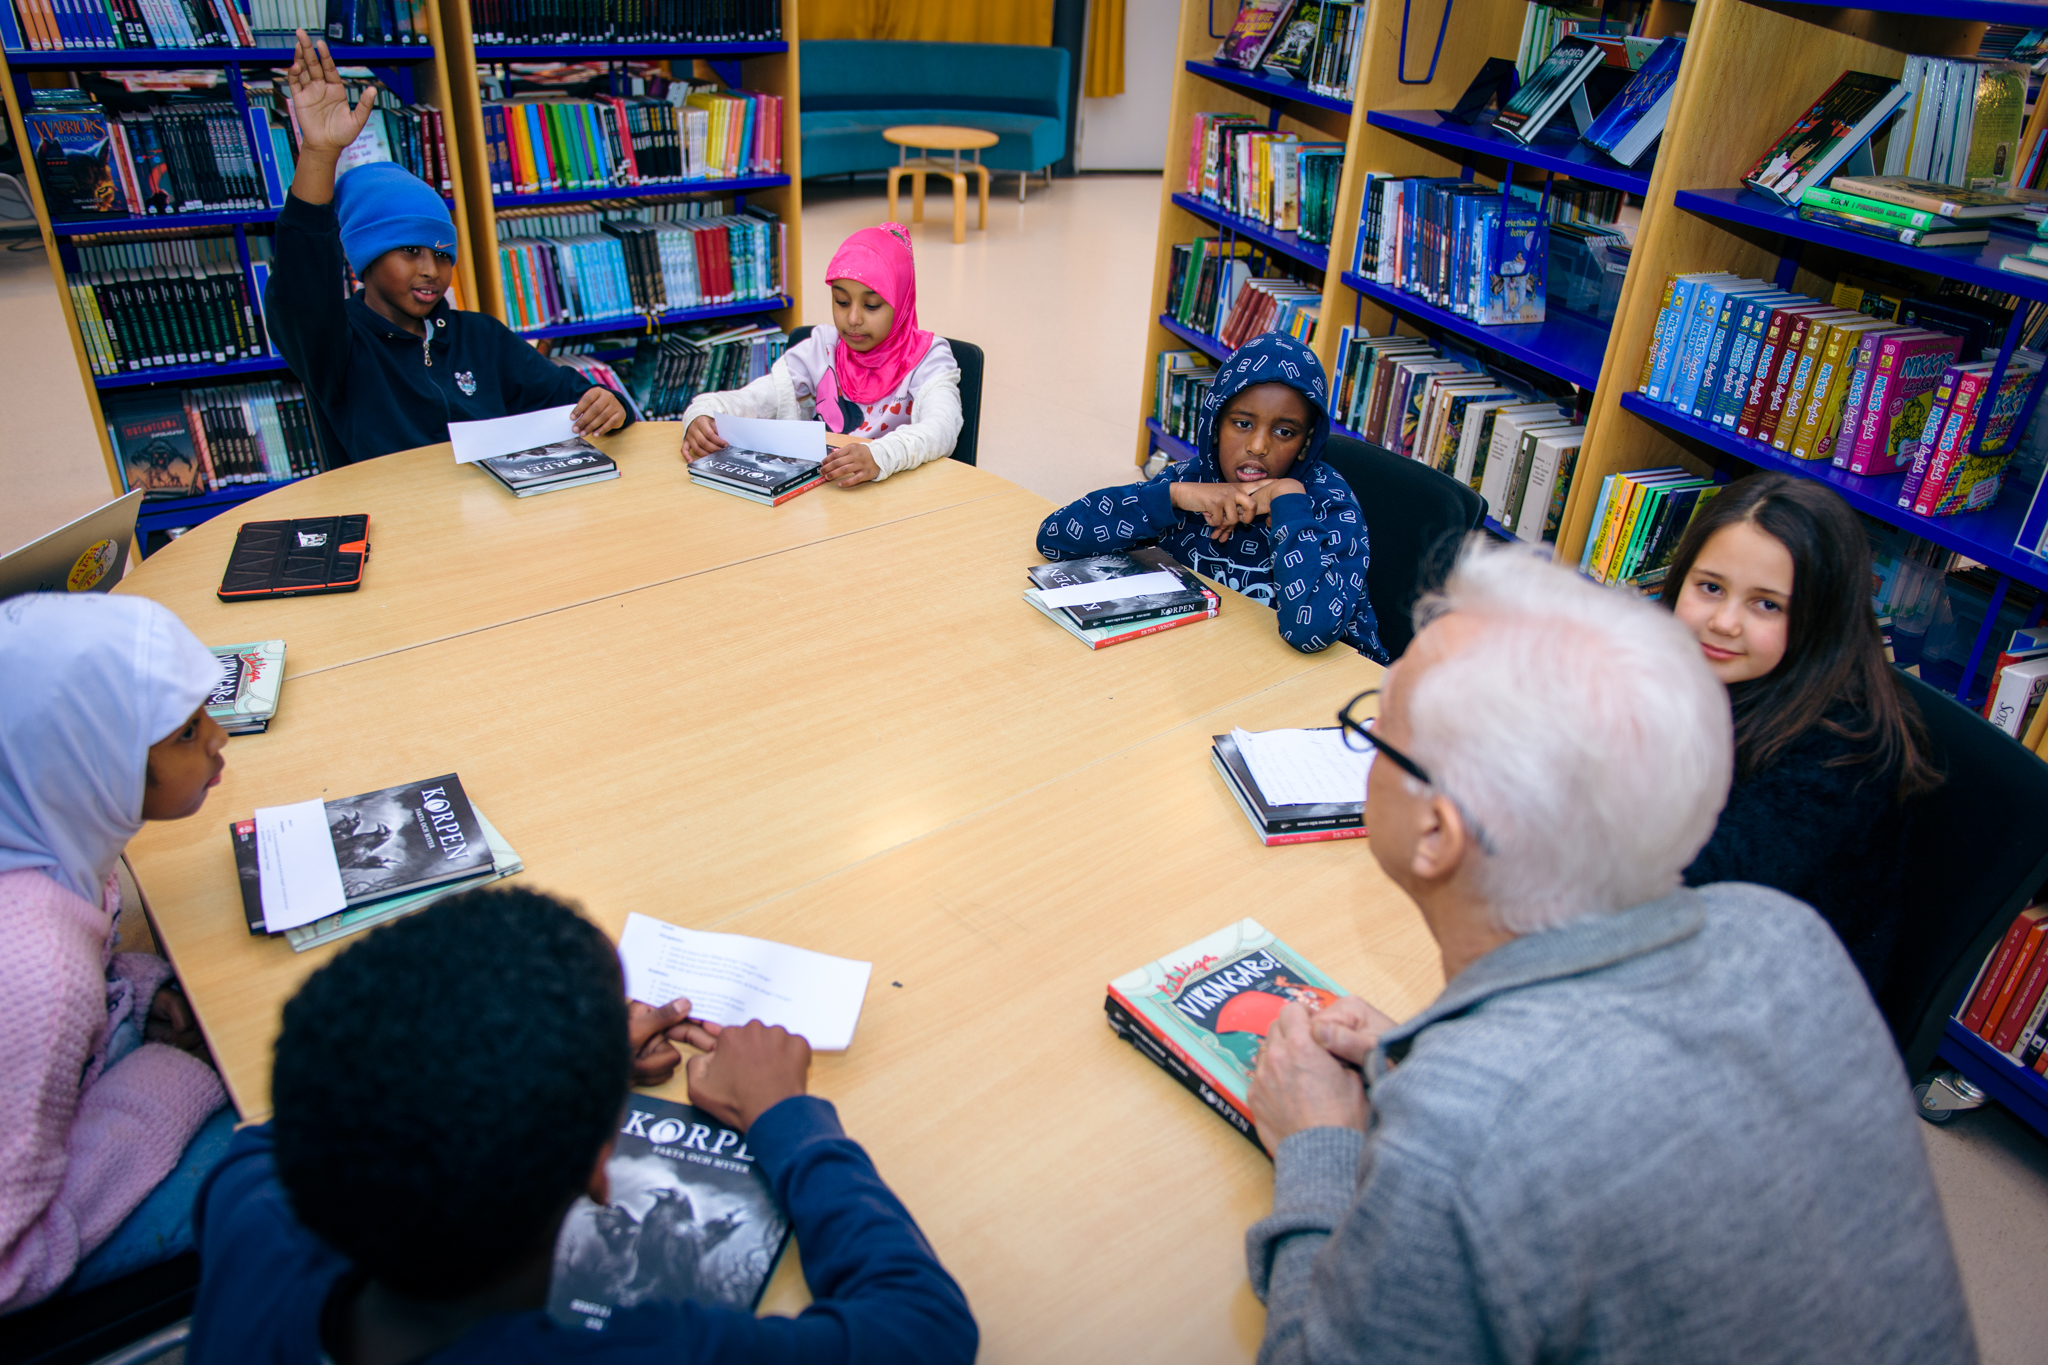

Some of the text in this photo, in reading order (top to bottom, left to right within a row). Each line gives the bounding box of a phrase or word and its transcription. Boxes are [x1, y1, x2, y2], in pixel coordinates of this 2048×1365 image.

[33, 119, 105, 141] WARRIORS
[1830, 196, 1849, 208] EGON
[513, 455, 598, 477] KORPEN
[702, 460, 776, 482] KORPEN
[1618, 529, 1630, 553] HÄLFTEN
[1160, 604, 1195, 616] KORPEN
[421, 786, 470, 860] KORPEN
[1174, 948, 1283, 1020] VIKINGAR!
[1199, 1082, 1249, 1132] KORPEN
[620, 1109, 755, 1162] KORP
[652, 1145, 685, 1160] FAKTA
[686, 1152, 712, 1165] OCH
